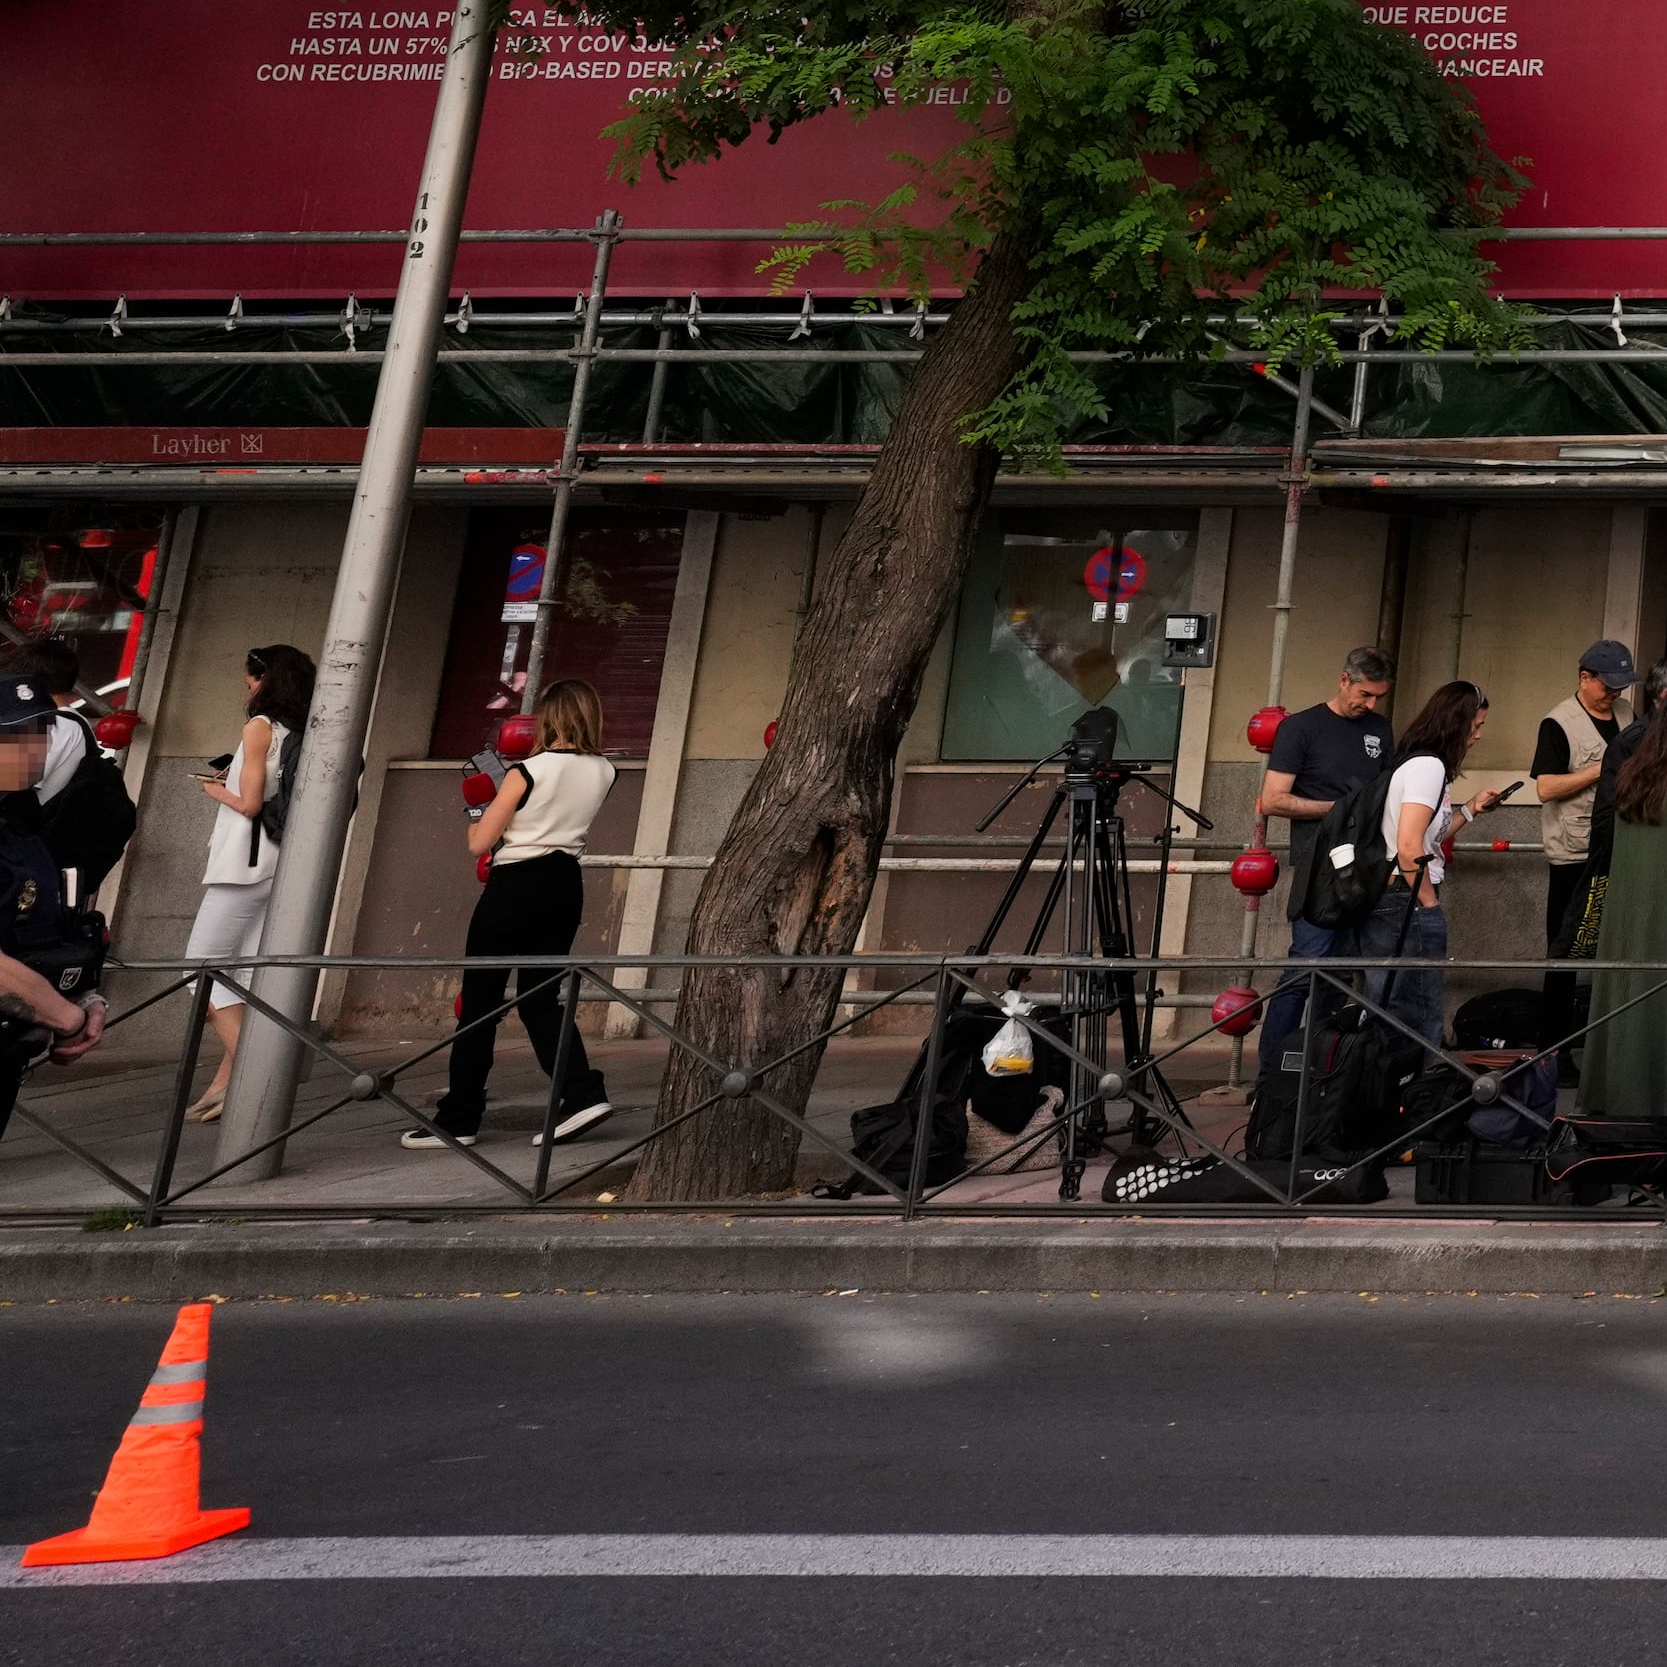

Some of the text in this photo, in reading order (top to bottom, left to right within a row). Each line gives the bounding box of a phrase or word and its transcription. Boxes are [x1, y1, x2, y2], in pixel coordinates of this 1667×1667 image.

[307, 11, 364, 29] ESTA
[368, 11, 430, 29] LONA
[1414, 6, 1508, 24] REDUCE
[289, 37, 363, 55] HASTA
[367, 37, 400, 55] UN
[404, 36, 449, 55] 57%
[558, 36, 574, 53] Y
[577, 35, 626, 53] COV
[1423, 33, 1518, 51] COCHES
[256, 64, 305, 82] CON
[310, 62, 493, 82] RECUBRIMIE
[499, 61, 621, 80] BIO-BASED
[152, 434, 231, 458] Layher
